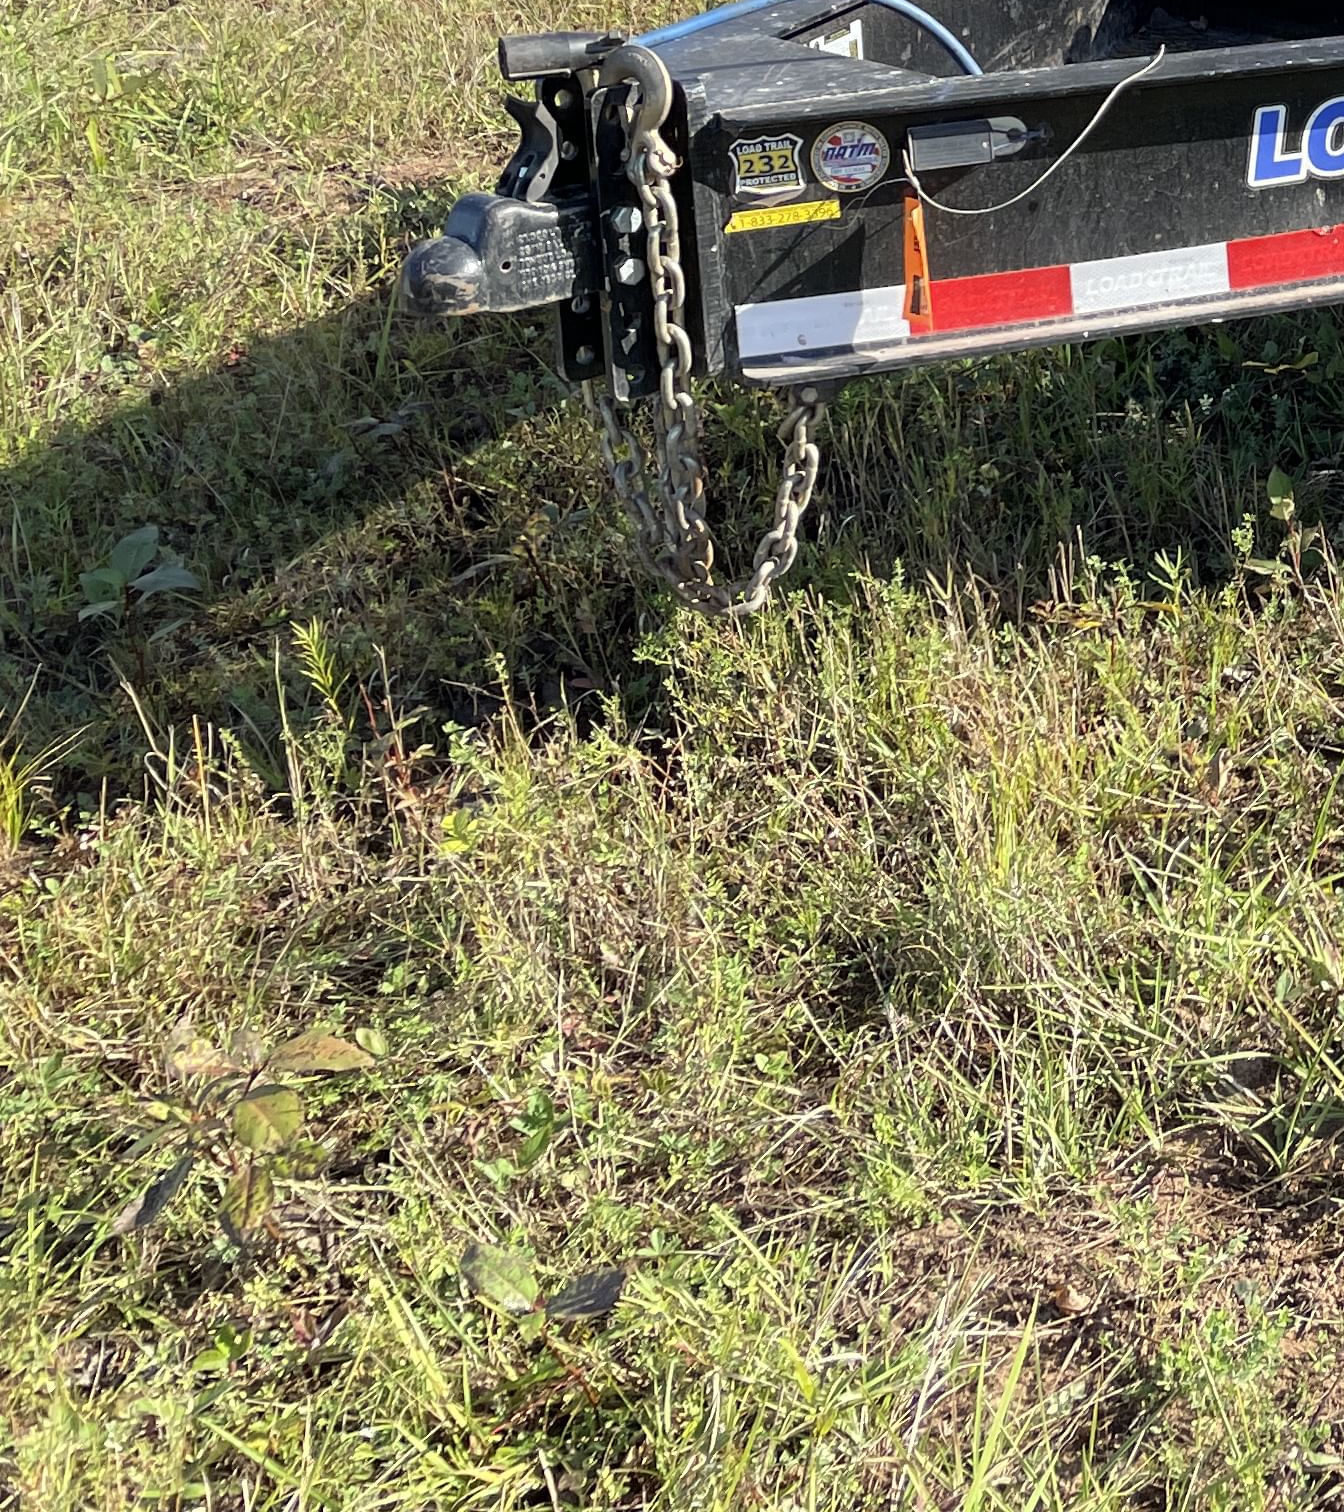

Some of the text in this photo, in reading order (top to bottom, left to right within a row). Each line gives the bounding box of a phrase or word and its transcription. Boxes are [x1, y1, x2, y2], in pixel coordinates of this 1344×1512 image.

[735, 140, 793, 155] LOAD TRAIL
[742, 155, 790, 173] 232
[739, 173, 797, 186] PROTECTED
